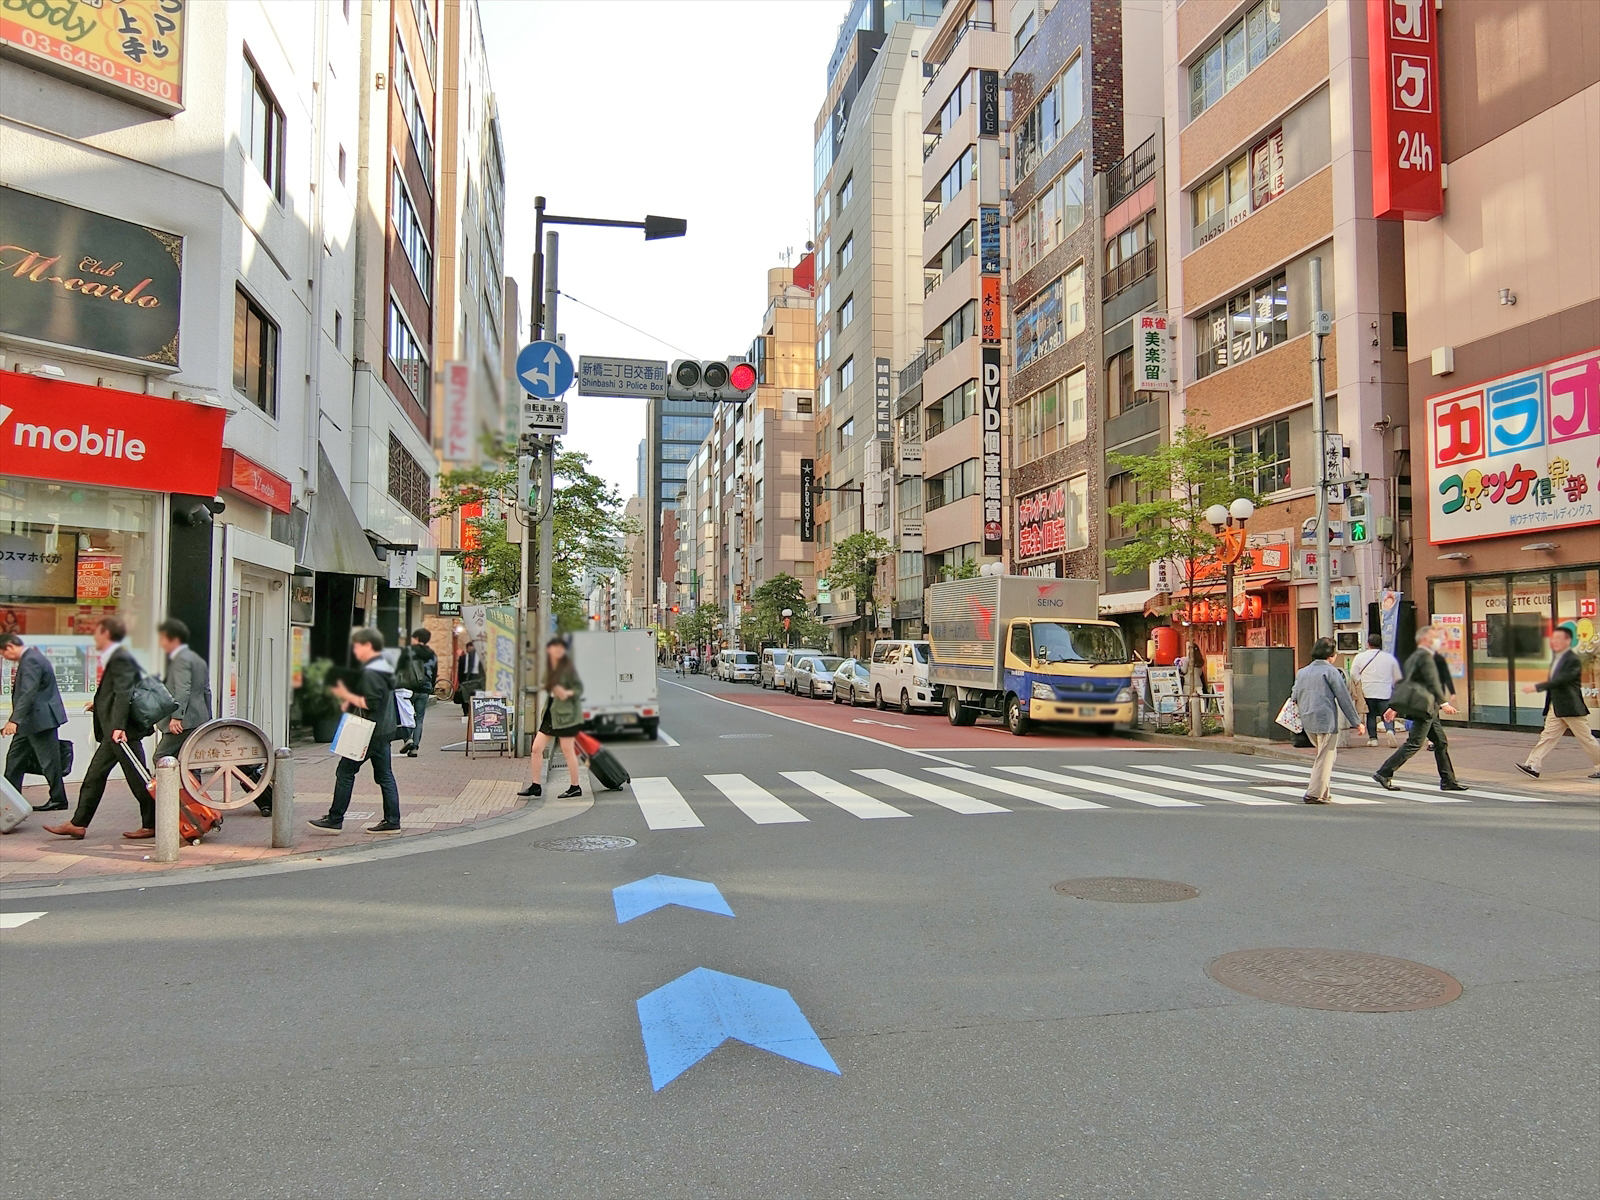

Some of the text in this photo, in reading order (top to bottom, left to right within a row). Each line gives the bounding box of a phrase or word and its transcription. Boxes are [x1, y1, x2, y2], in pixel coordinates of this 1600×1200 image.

[22, 29, 172, 99] 03-6450-1390
[984, 83, 994, 131] GRACE
[1398, 130, 1433, 172] 24h
[78, 255, 124, 277] Club
[1141, 317, 1167, 330] 麻雀
[1144, 331, 1161, 380] 美楽留
[582, 362, 665, 381] 新橋三丁目交番前
[582, 379, 664, 391] Shinbashi 3 Police Box
[524, 403, 565, 414] 自転車を除く
[877, 364, 889, 432] MANZEN
[524, 413, 565, 424] 一方通行
[14, 422, 146, 461] mobile
[803, 507, 811, 539] HOTELS
[1019, 517, 1066, 558] 完全個室
[82, 562, 97, 570] au
[1037, 598, 1064, 607] SEINO
[194, 746, 260, 760] 新橋三丁目
